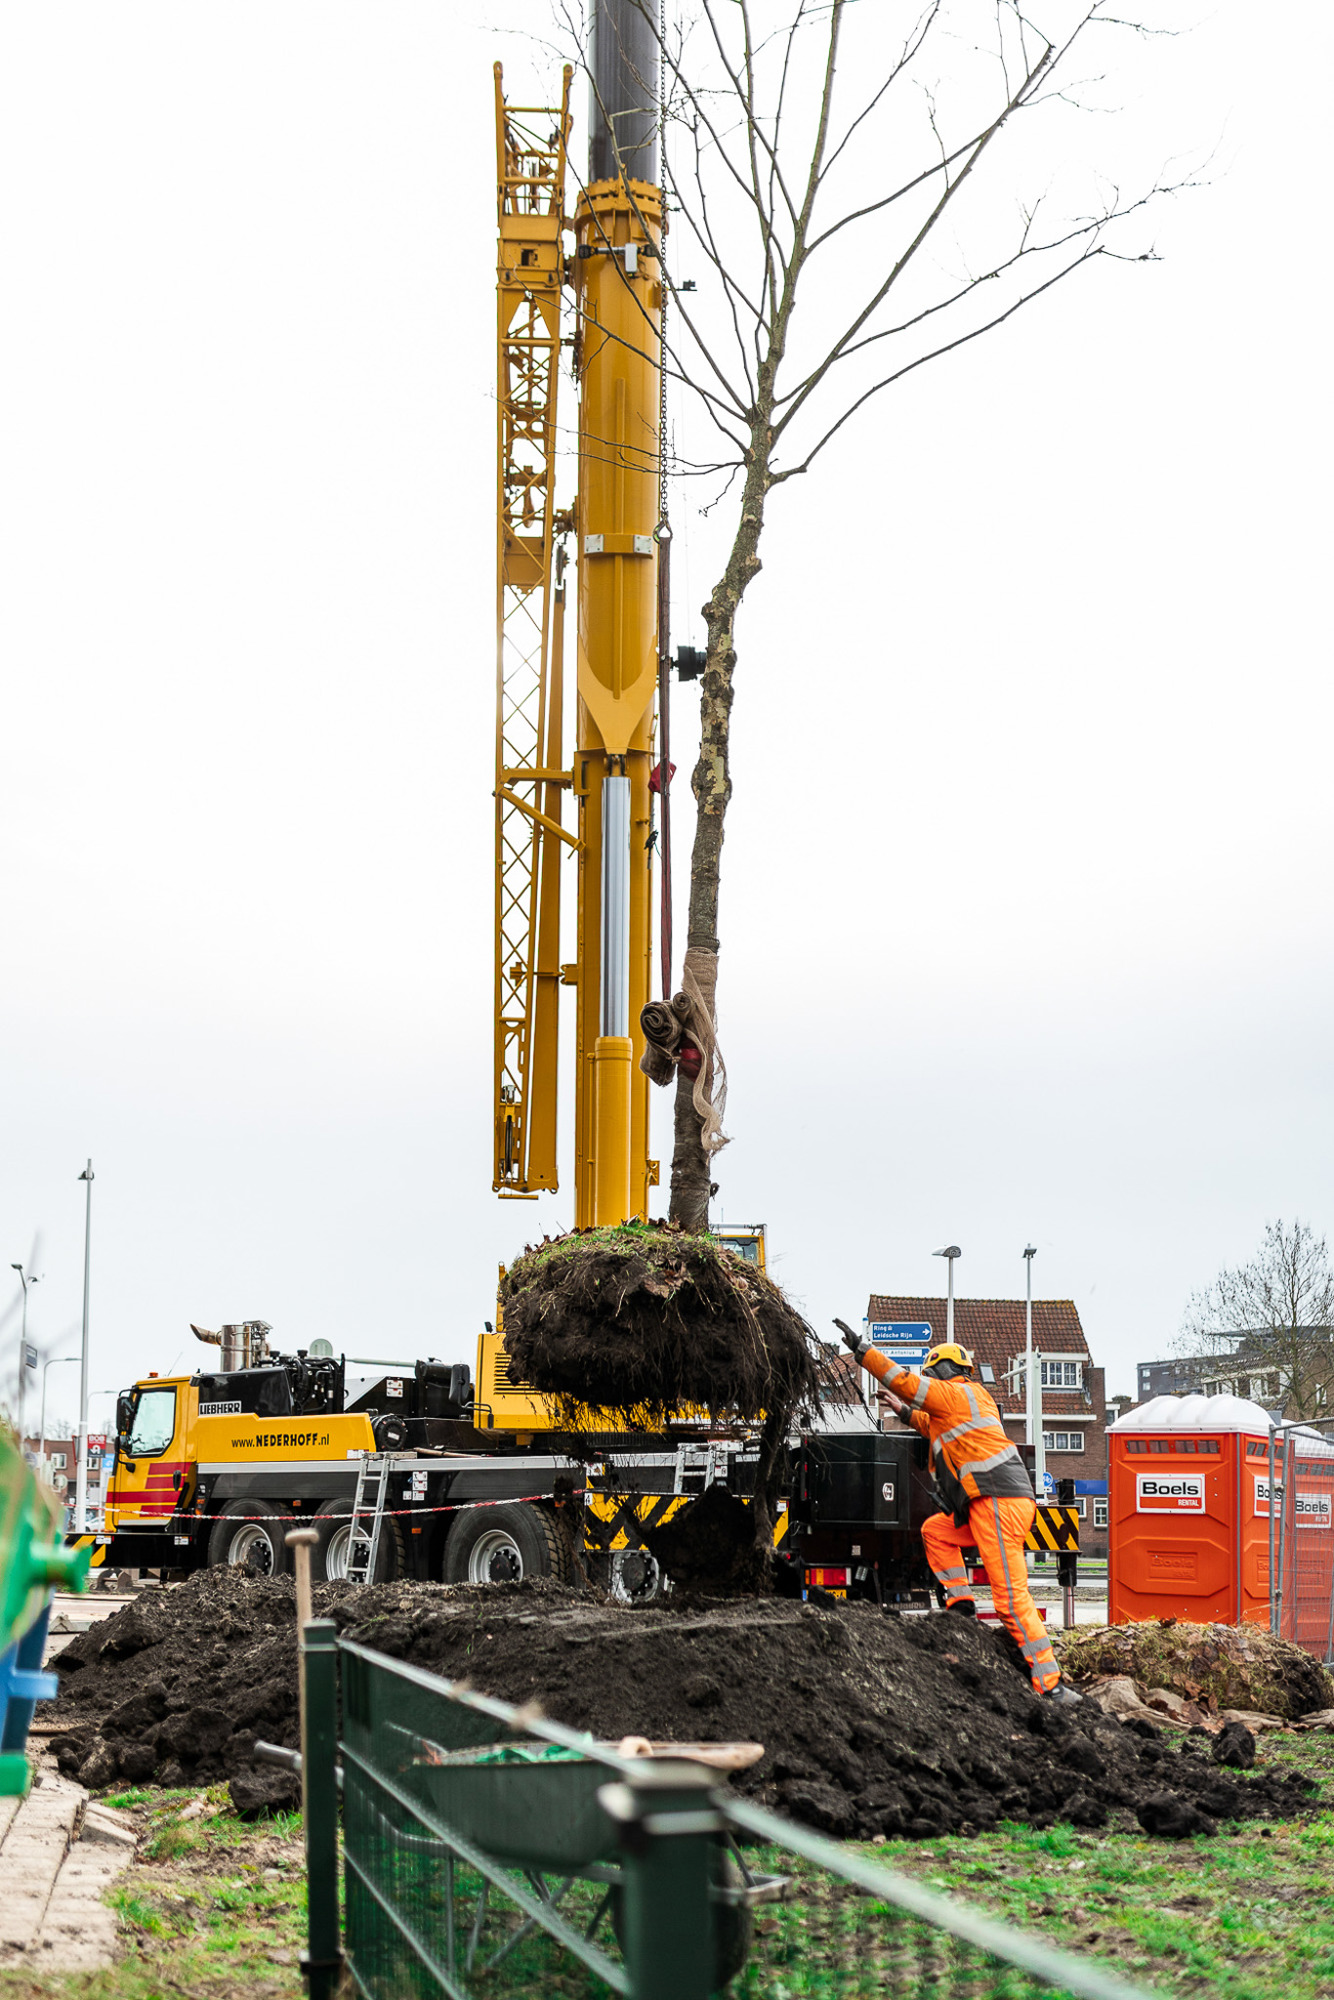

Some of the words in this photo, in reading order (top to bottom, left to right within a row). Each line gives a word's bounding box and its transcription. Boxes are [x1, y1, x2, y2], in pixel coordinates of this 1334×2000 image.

[200, 1402, 241, 1415] LIEBHERR
[231, 1433, 330, 1448] www.NEDERHOFF.nl
[1142, 1481, 1199, 1495] Boels
[1257, 1484, 1282, 1500] Bos
[1177, 1499, 1199, 1507] RENTAL
[1295, 1500, 1329, 1513] Boels
